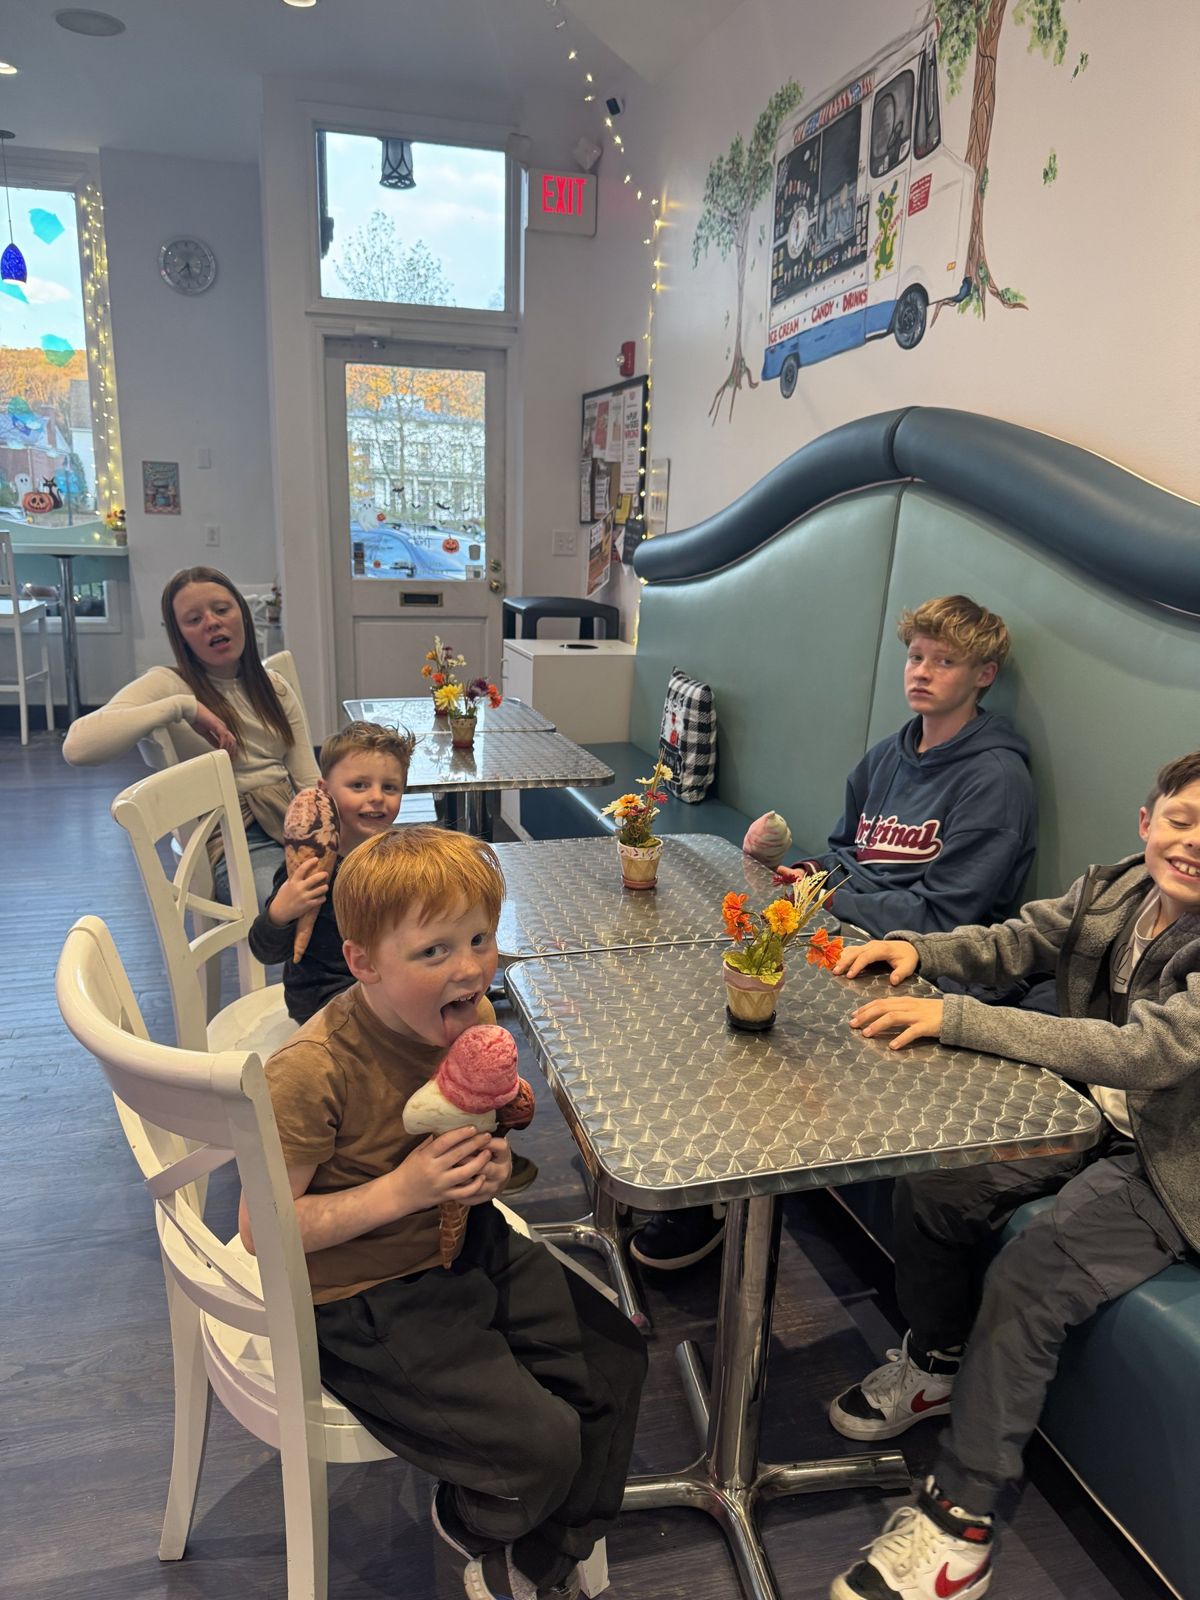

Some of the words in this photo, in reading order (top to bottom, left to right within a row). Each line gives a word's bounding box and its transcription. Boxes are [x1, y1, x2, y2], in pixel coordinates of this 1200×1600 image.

[542, 174, 587, 217] EXIT
[768, 329, 778, 344] ICE
[778, 318, 799, 339] CREAM
[812, 301, 834, 323] CANDY
[843, 289, 867, 312] DRINKS
[854, 813, 941, 852] rginal
